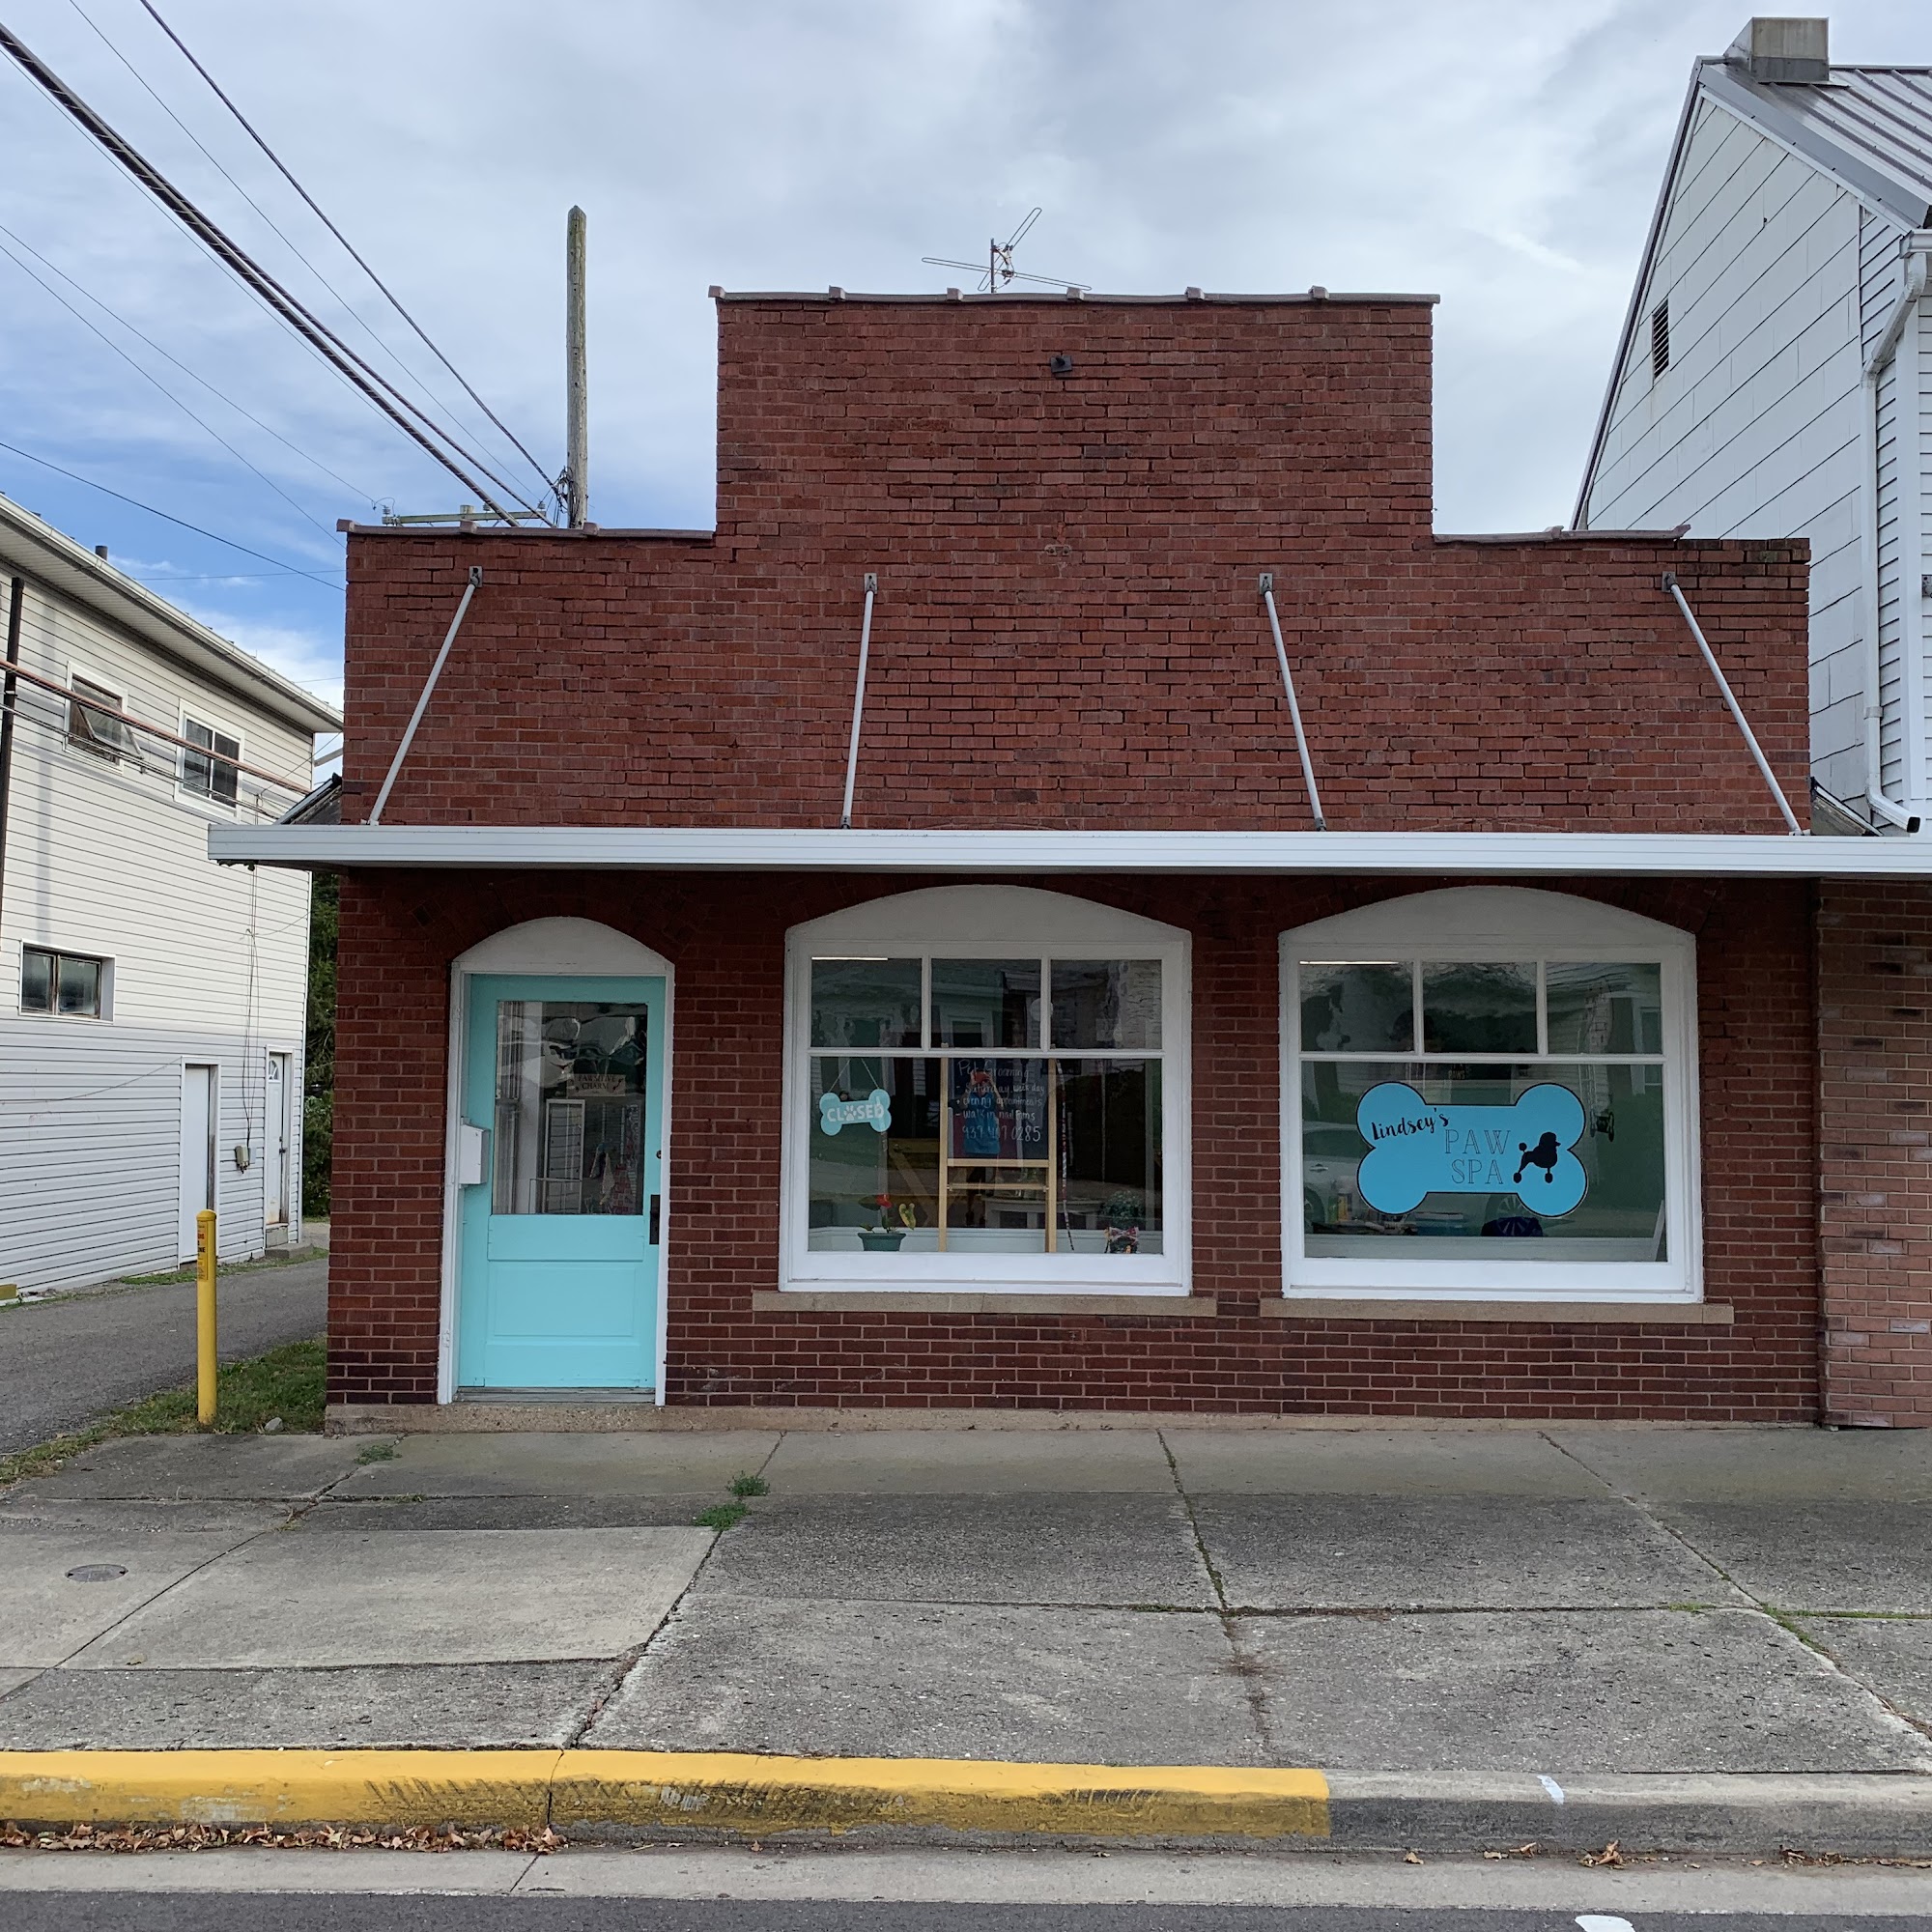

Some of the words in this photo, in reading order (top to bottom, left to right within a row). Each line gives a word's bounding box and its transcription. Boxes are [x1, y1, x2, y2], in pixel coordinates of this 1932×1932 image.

[957, 1059, 979, 1076] Pet
[1010, 1124, 1042, 1142] 0285
[1444, 1129, 1511, 1154] PAW
[1451, 1159, 1504, 1184] SPA
